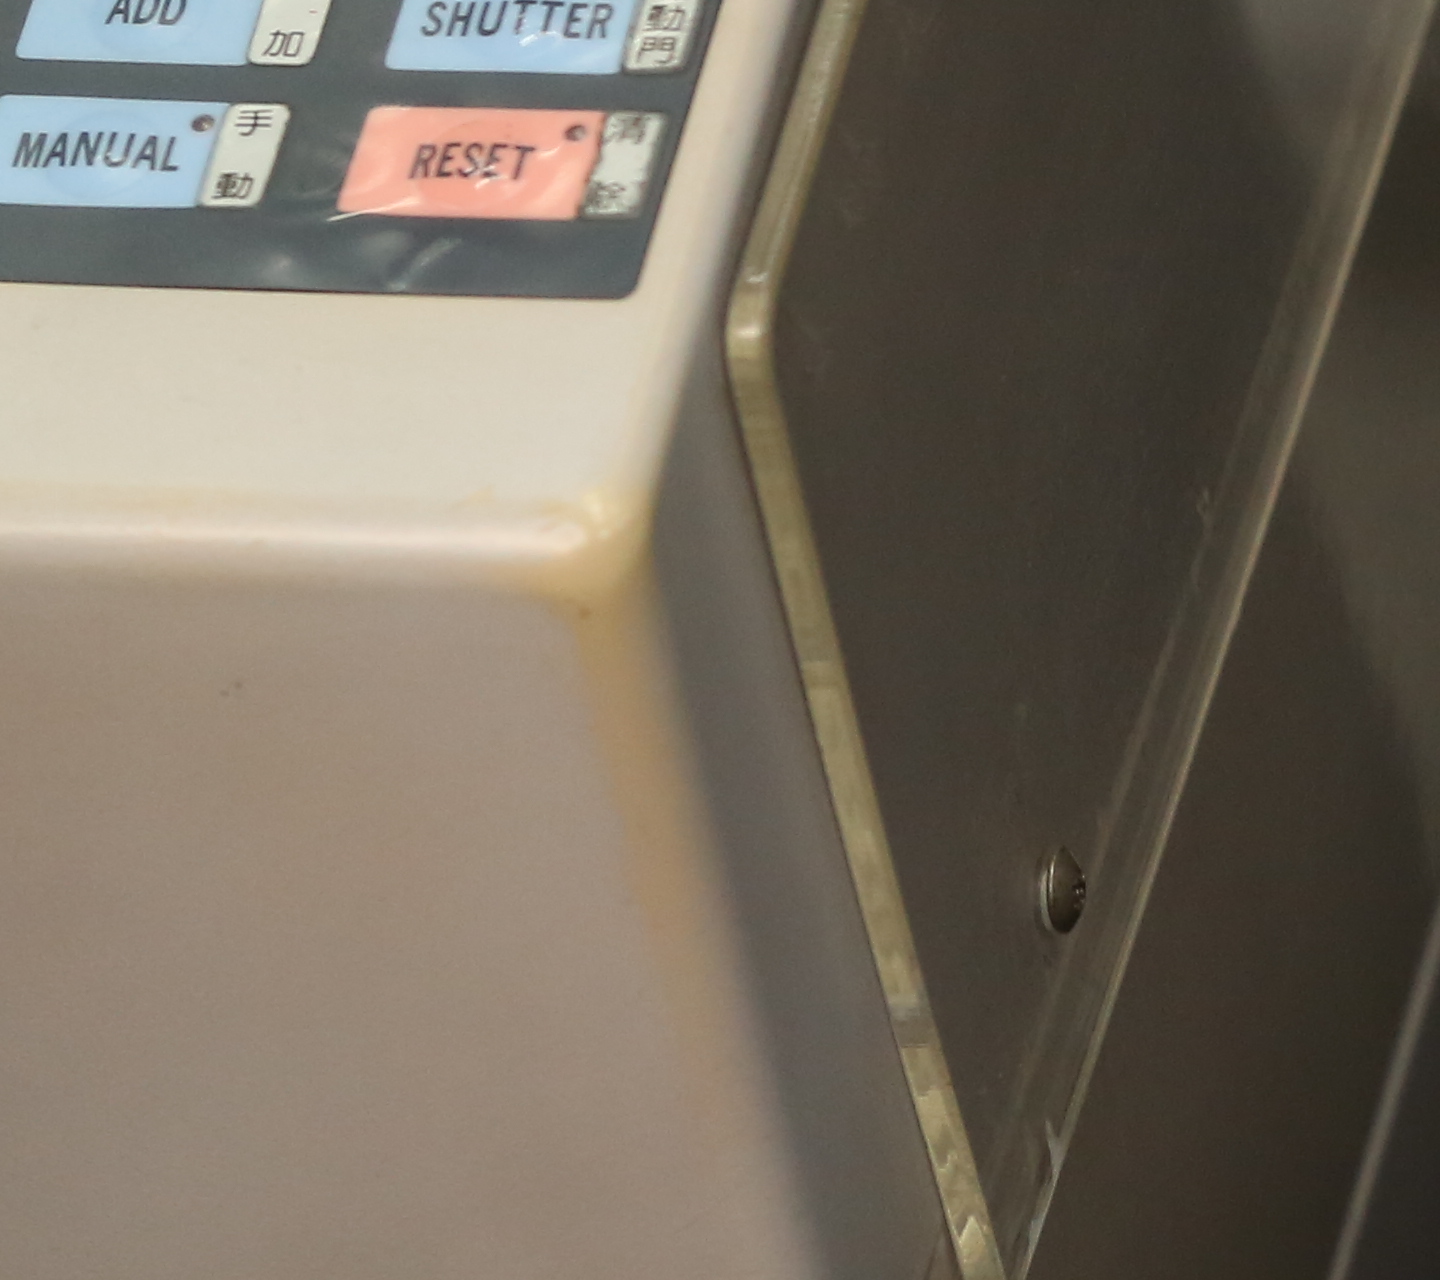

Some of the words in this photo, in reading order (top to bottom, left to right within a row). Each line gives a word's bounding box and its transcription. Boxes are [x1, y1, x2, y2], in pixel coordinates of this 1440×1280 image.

[11, 130, 181, 172] MANUAL
[212, 108, 274, 202] 手動
[408, 142, 536, 181] RESET
